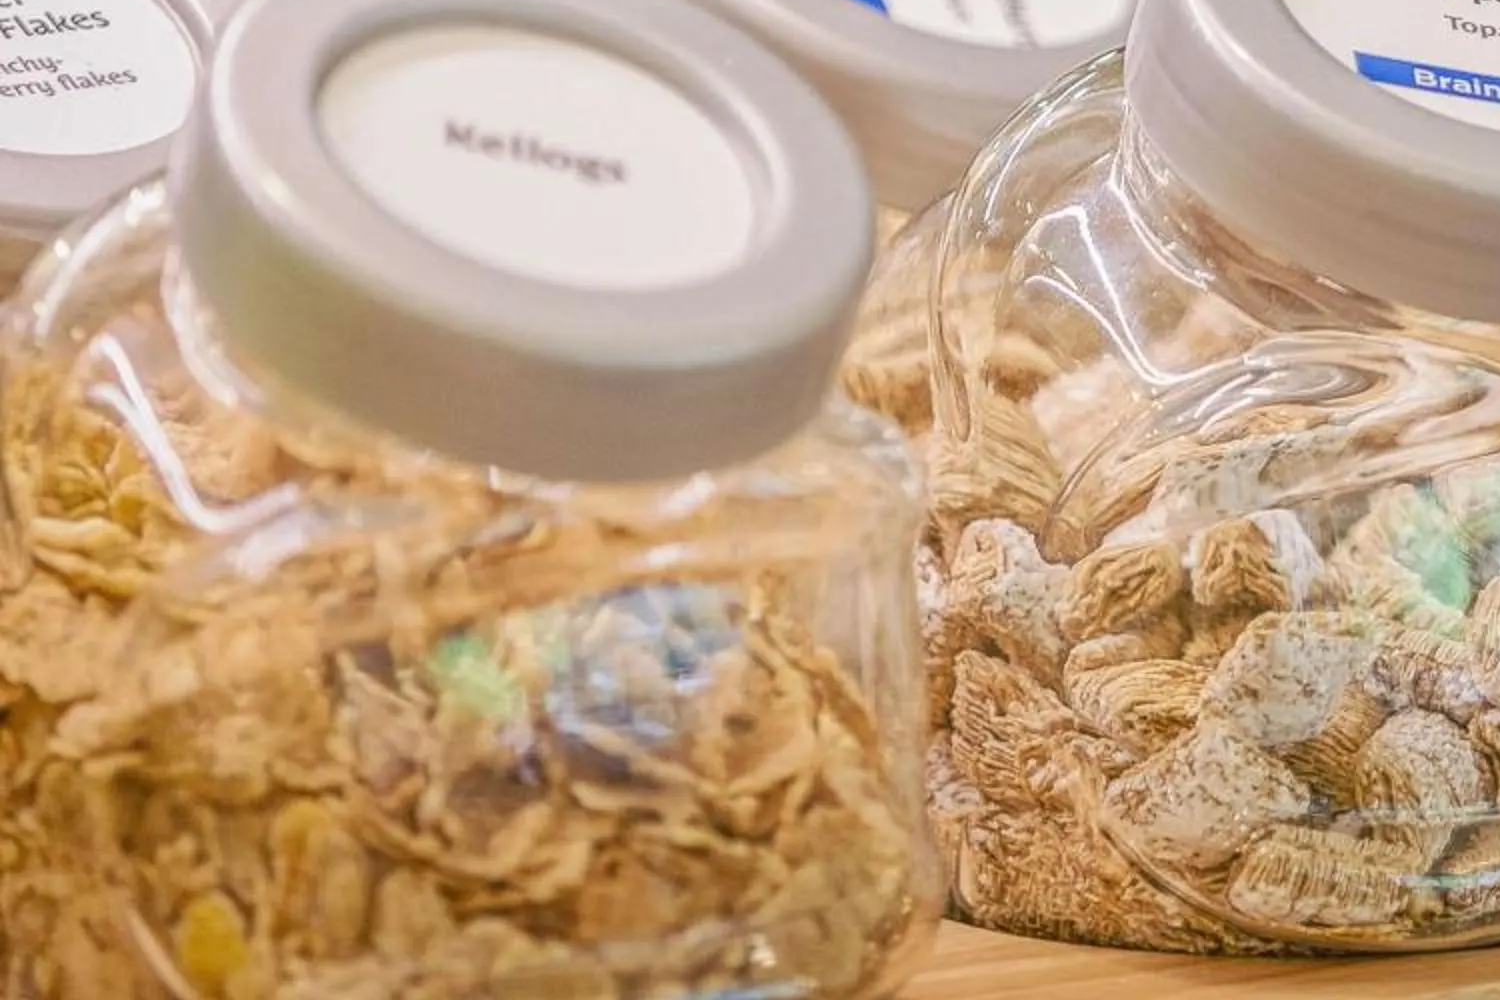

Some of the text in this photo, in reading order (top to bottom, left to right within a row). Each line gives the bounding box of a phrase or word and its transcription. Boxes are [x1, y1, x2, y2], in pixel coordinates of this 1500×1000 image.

[0, 11, 111, 39] Flakes
[57, 70, 139, 91] flakes
[444, 118, 627, 188] Kellogs
